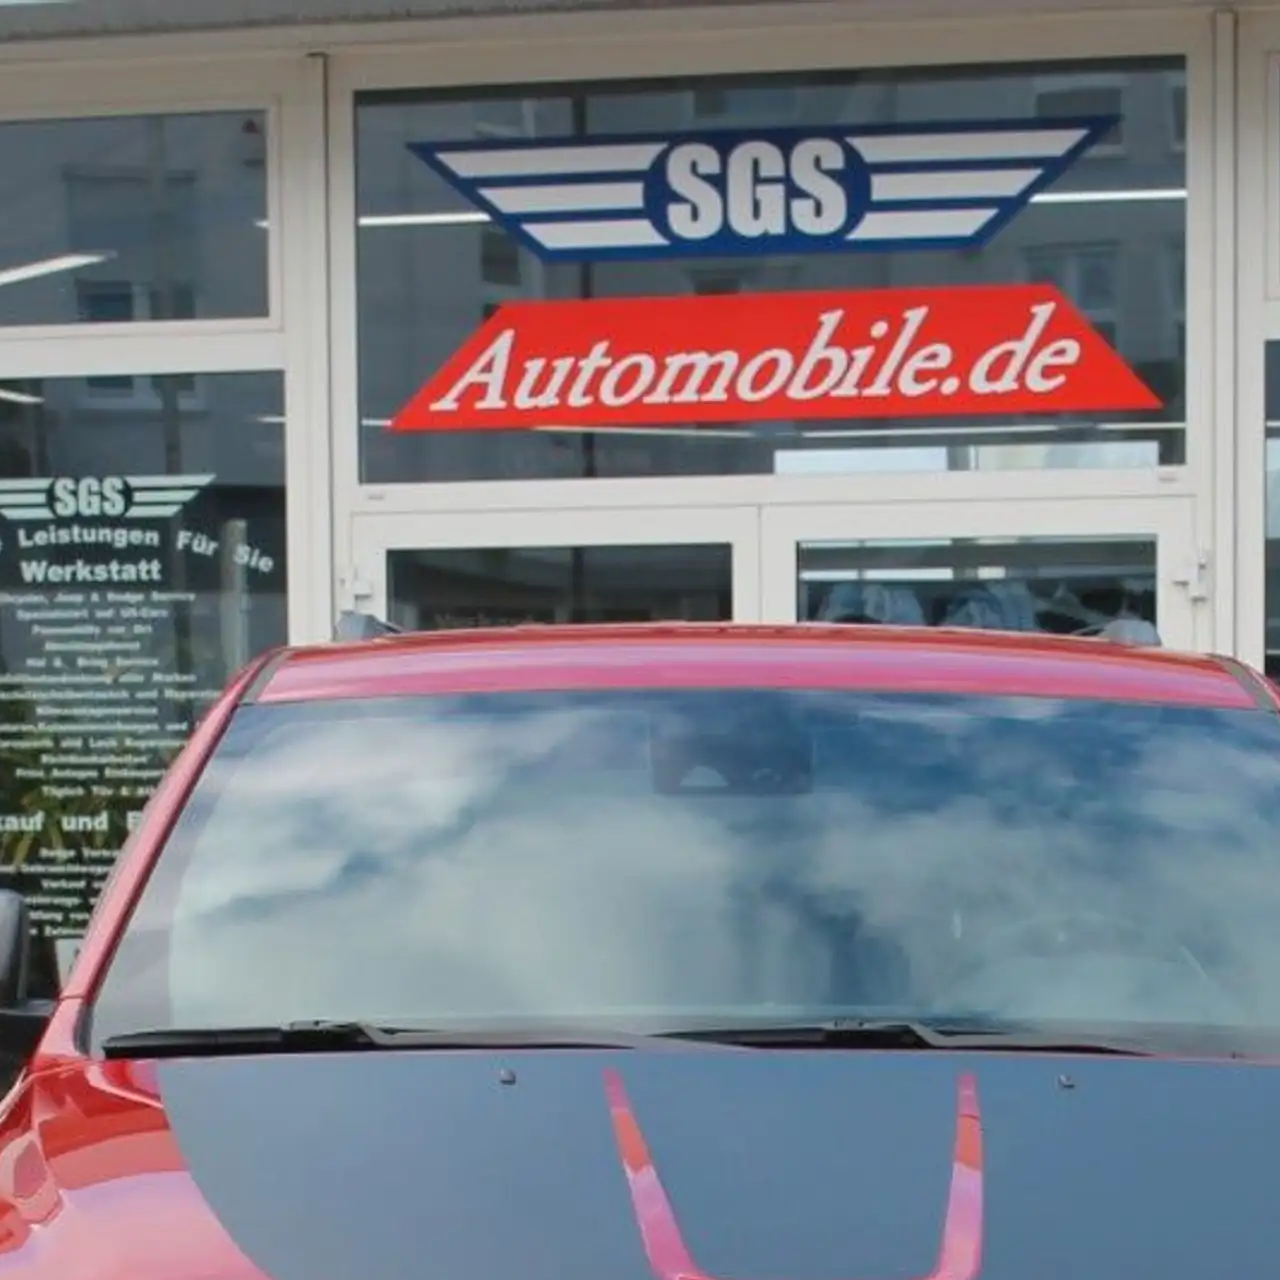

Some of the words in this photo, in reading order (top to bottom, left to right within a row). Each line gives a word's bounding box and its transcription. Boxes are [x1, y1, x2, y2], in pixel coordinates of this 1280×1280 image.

[666, 138, 848, 241] SGS
[429, 301, 1082, 411] Automobile.de
[52, 475, 127, 518] SGS
[16, 526, 161, 550] Leistungen
[176, 529, 219, 558] Für
[232, 544, 276, 574] Sie
[20, 559, 163, 584] Werkstatt
[61, 811, 109, 832] und
